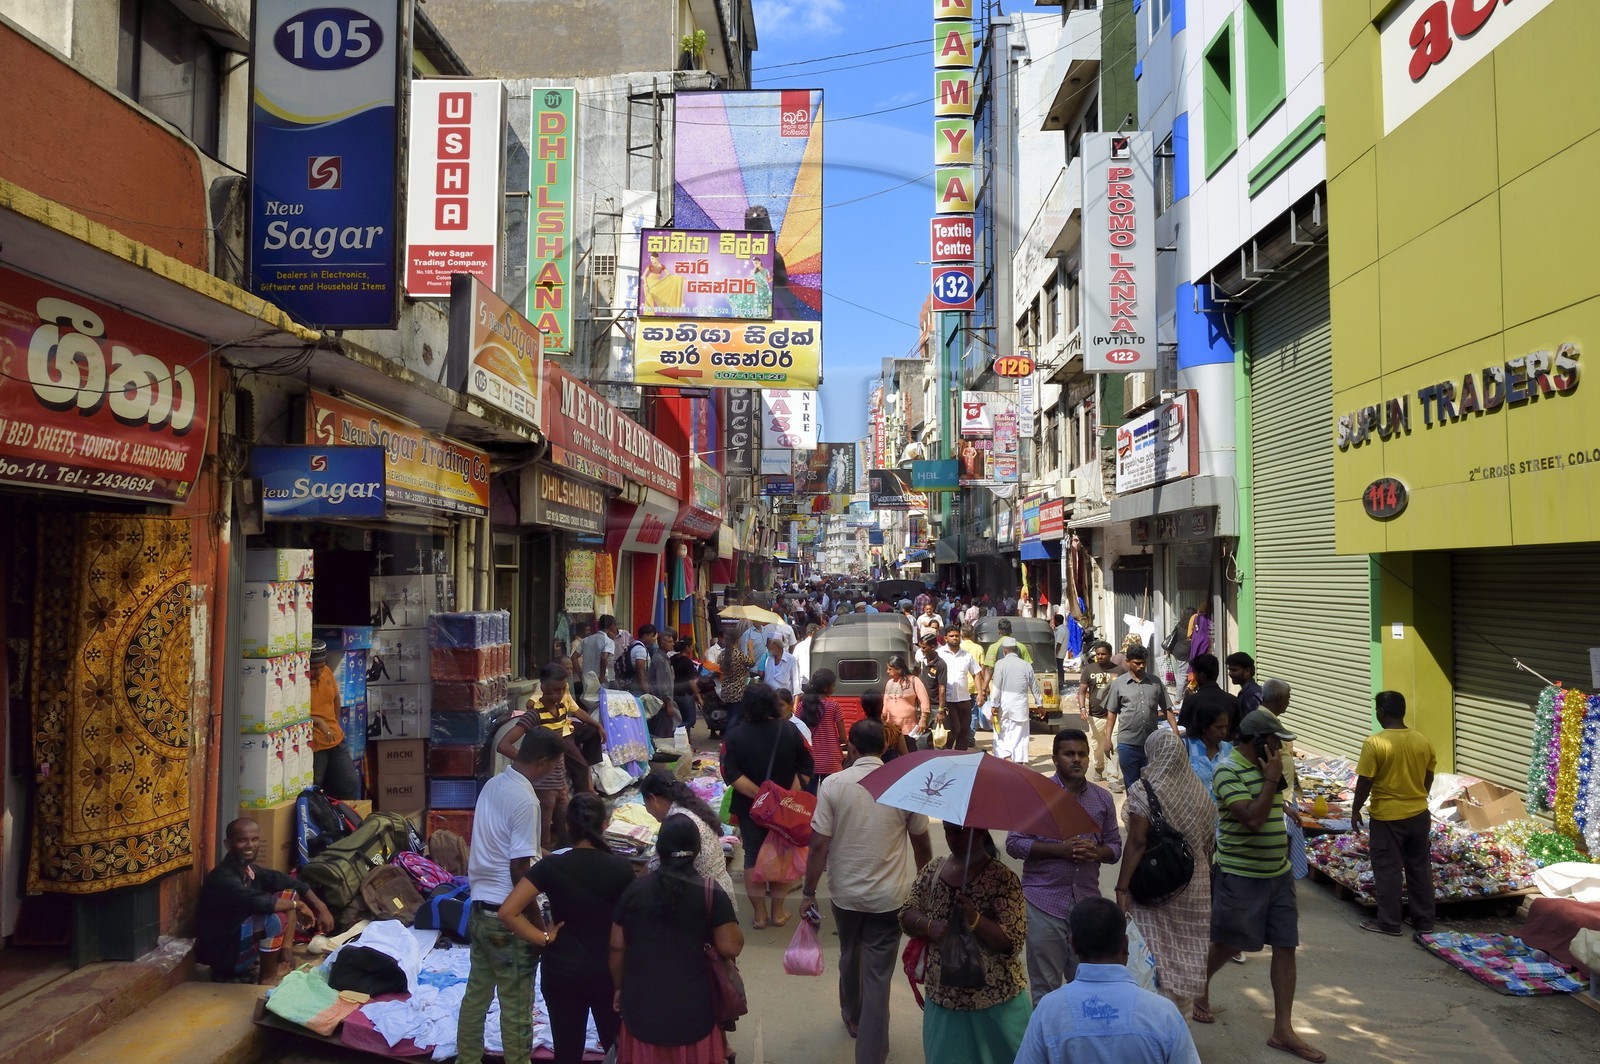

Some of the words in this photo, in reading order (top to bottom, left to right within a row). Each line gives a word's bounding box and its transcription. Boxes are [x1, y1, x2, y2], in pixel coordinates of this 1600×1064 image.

[286, 19, 372, 59] 105
[1409, 0, 1509, 80] ac
[441, 97, 466, 225] USHA
[265, 201, 304, 216] New
[1107, 167, 1134, 246] PROMO
[536, 112, 567, 334] DHILSHANA
[934, 223, 972, 238] Textile
[263, 220, 384, 258] Sagar
[936, 241, 971, 256] Centre
[414, 259, 446, 267] Trading
[447, 259, 488, 267] Company.
[449, 250, 474, 258] Sagar
[260, 283, 294, 293] Giftware
[298, 282, 314, 292] and
[316, 281, 357, 292] Household
[360, 282, 386, 292] Items
[276, 271, 306, 281] Dealers
[310, 271, 318, 281] in
[320, 269, 369, 281] Electronics,
[935, 277, 969, 298] 132
[1109, 252, 1136, 333] LANKA
[503, 312, 538, 360] Sagar
[544, 336, 563, 348] EX
[642, 323, 731, 343] සානියා
[1092, 336, 1145, 345] (PVT)LTD
[999, 358, 1031, 377] 126
[1111, 352, 1134, 362] 122
[1336, 393, 1412, 452] SUPUN
[1417, 342, 1581, 428] TRADERS
[561, 375, 614, 442] METRO
[617, 414, 651, 464] TRADE
[653, 439, 681, 481] CENTRE
[730, 389, 749, 463] GUCCI
[6, 422, 34, 446] BED
[34, 426, 77, 457] SHEETS,
[79, 434, 122, 461] TOWELS
[121, 443, 130, 462] &
[130, 444, 188, 472] HANDLOOMS
[341, 419, 367, 445] New
[368, 418, 417, 466] Sagar
[421, 437, 470, 484] Trading
[472, 455, 488, 482] Co.
[56, 466, 78, 483] Tel
[92, 472, 155, 493] 2434694
[1482, 462, 1516, 480] CROSS
[1519, 454, 1565, 474] STREET,
[292, 477, 381, 504] Sagar
[541, 474, 590, 511] DHILSHANA
[1369, 481, 1397, 511] 114
[387, 751, 413, 759] HACHI
[386, 787, 413, 795] HACHI
